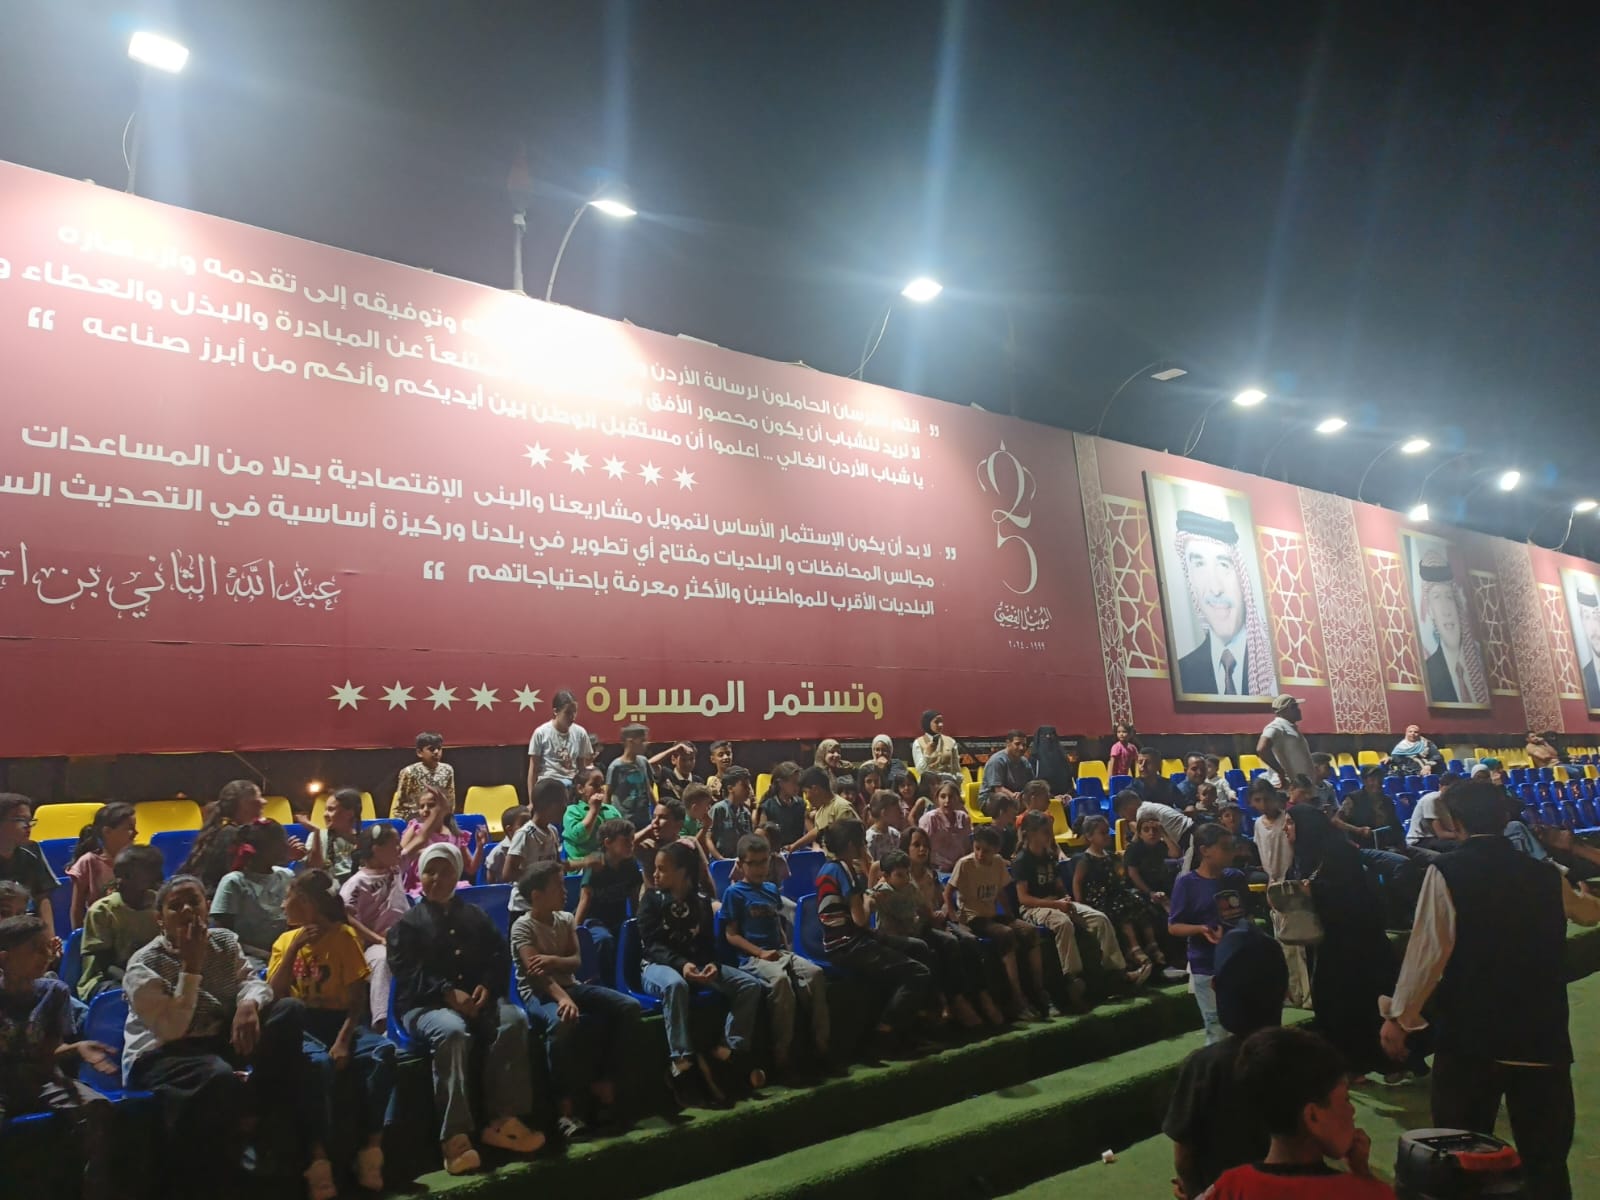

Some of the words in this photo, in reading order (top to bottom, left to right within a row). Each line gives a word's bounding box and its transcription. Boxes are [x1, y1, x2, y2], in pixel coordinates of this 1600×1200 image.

[21, 262, 164, 311] والعطاء
[203, 258, 297, 293] تقدمه
[170, 292, 269, 331] والبذل
[303, 285, 347, 311] إلى
[353, 291, 457, 333] وتوفيقه
[82, 318, 191, 354] صناعه
[275, 310, 380, 349] المبادرة
[198, 337, 245, 367] أبرز
[385, 336, 424, 359] عن
[252, 348, 297, 375] من
[650, 363, 701, 387] الأردن
[303, 362, 389, 393] وأنكم
[703, 371, 759, 401] لرسالة
[488, 394, 527, 420] بين
[761, 388, 831, 415] الحاملون
[600, 416, 682, 446] مستقبل
[697, 406, 759, 430] محصور
[761, 416, 804, 441] يكون
[21, 426, 210, 468] المساعدات
[685, 429, 705, 451] أن
[806, 424, 823, 443] أن
[825, 432, 881, 452] للشباب
[217, 449, 264, 476] من
[776, 451, 827, 472] الغالي
[911, 446, 921, 460] لا
[271, 456, 322, 486] بدلا
[327, 459, 463, 504] الإقتصادية
[828, 458, 869, 478] الأردن
[871, 467, 911, 486] شباب
[912, 472, 925, 491] يا
[60, 473, 203, 512] التحديث
[473, 486, 545, 514] والبنى
[209, 495, 262, 527] في
[267, 494, 377, 529] أساسية
[549, 493, 643, 524] مشاريعنا
[646, 508, 710, 531] لتمويل
[382, 509, 466, 543] وركيزة
[471, 520, 525, 549] بلدنا
[712, 518, 775, 539] الأساس
[529, 531, 565, 557] في
[570, 536, 629, 557] تطوير
[632, 537, 655, 567] أي
[659, 544, 711, 566] مفتاح
[847, 534, 886, 556] يكون
[887, 536, 903, 557] أن
[713, 550, 782, 574] البلديات
[797, 560, 882, 582] المحافظات
[468, 564, 609, 596] بإحتياجاتهم
[612, 570, 679, 598] معرفة
[683, 576, 741, 604] والأكثر
[883, 570, 935, 589] مجالس
[743, 585, 828, 609] للمواطنين
[830, 592, 877, 612] الأقرب
[878, 598, 935, 618] البلديات
[587, 676, 744, 721] المسيرة
[764, 682, 882, 720] وتستمر
